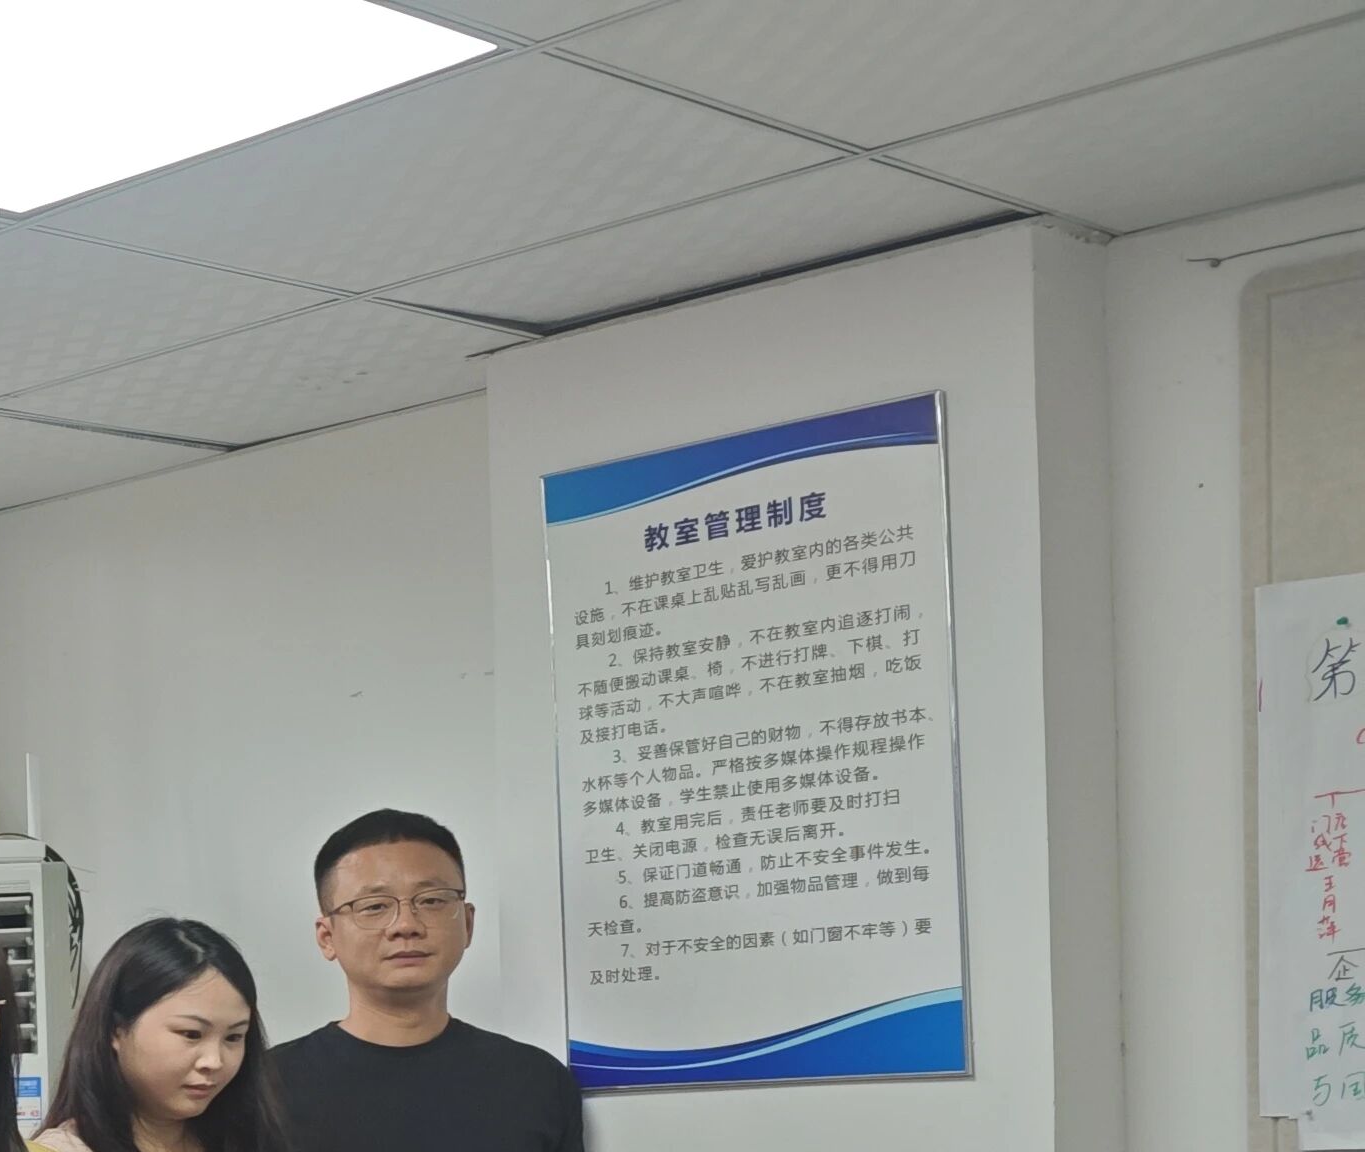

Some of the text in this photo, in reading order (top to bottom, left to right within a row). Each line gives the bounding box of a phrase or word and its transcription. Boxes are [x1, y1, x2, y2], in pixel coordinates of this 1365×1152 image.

[643, 492, 828, 553] 教室管理制度
[1312, 637, 1361, 702] 第
